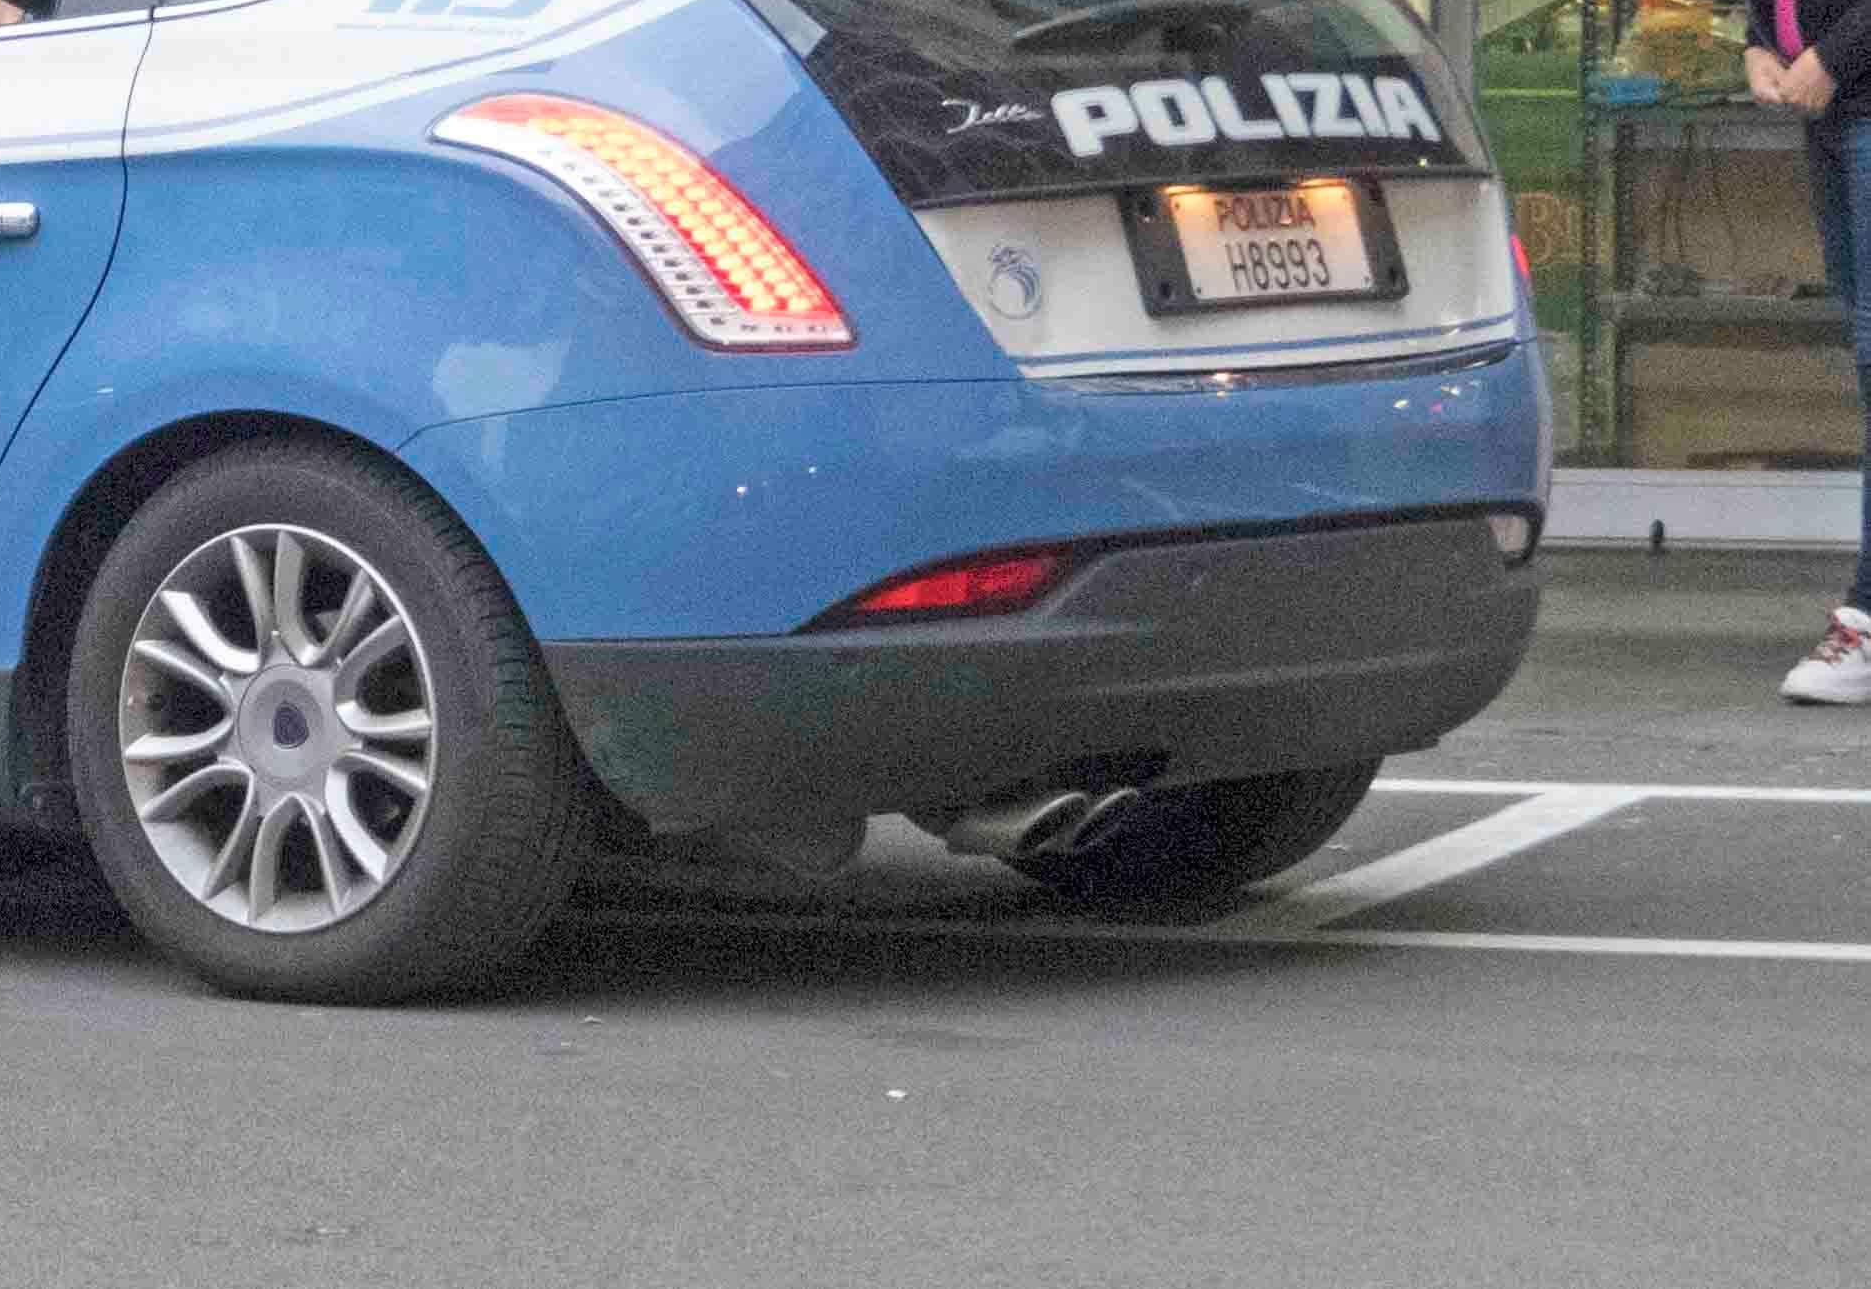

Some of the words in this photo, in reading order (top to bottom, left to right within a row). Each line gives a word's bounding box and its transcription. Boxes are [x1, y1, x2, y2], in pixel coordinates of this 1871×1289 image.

[1050, 72, 1441, 157] POLIZIA
[1214, 193, 1316, 231] POLIZIA
[1225, 238, 1332, 291] H8993
